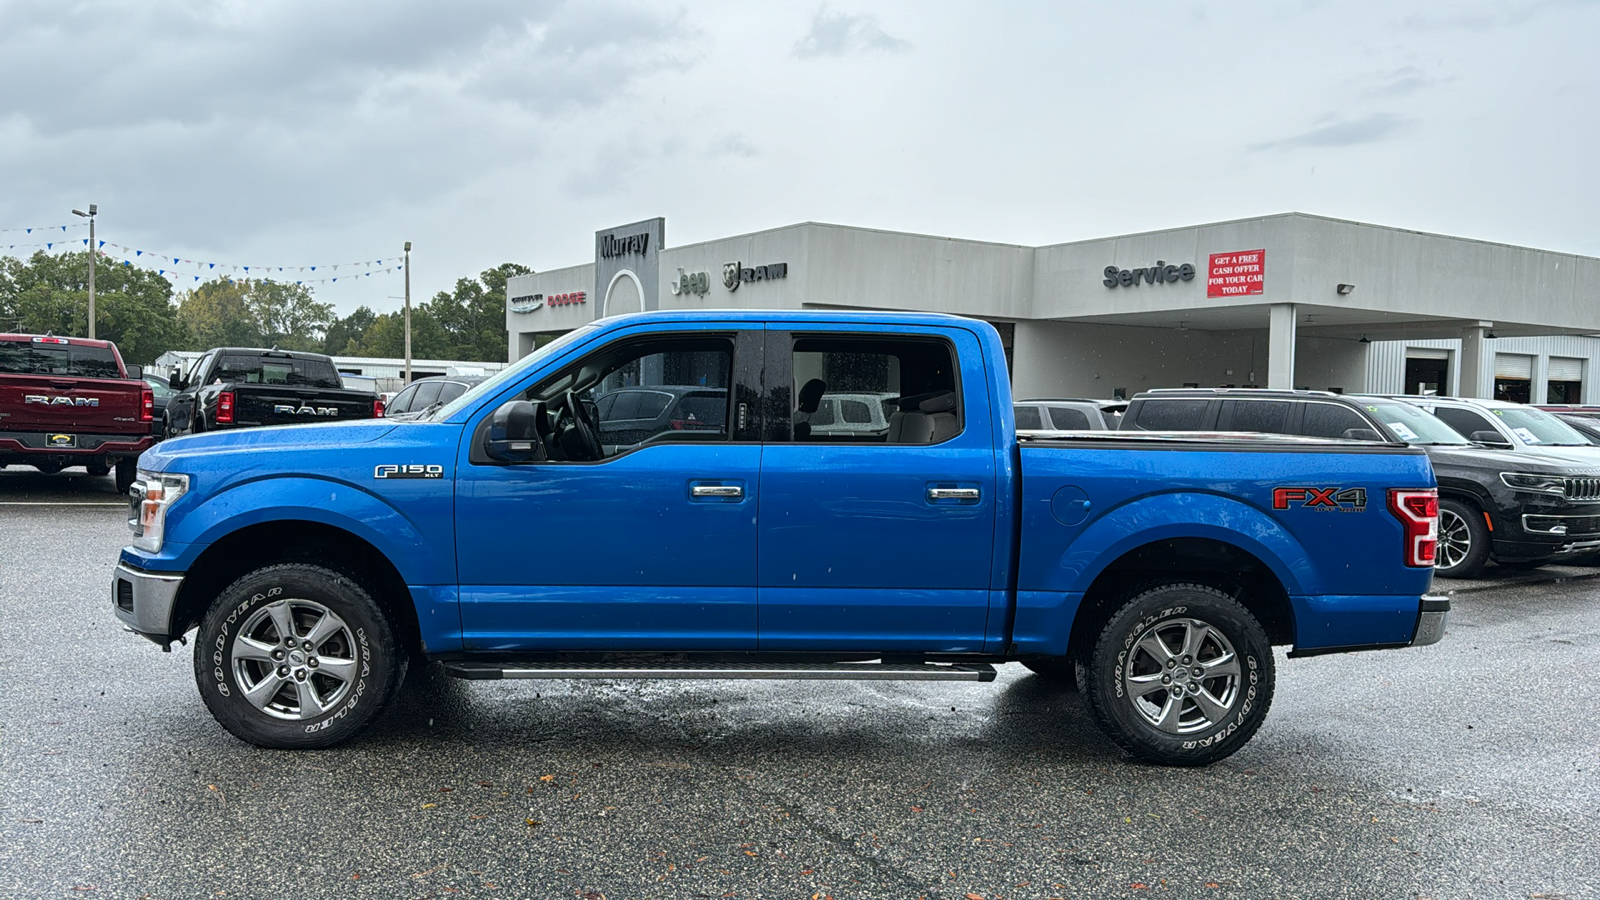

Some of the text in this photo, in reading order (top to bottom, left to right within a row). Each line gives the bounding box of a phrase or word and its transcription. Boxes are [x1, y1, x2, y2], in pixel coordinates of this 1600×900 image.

[601, 233, 649, 258] Murray
[1213, 265, 1260, 275] CASH OFFER
[1214, 254, 1259, 265] GET A FREE
[671, 268, 711, 298] Jeep
[740, 263, 788, 283] RAM
[1103, 260, 1196, 289] Service
[1208, 274, 1264, 286] FOR YOUR CAR
[547, 291, 587, 308] DODGE
[1221, 285, 1248, 294] TODAY
[25, 395, 99, 407] RAM
[274, 405, 339, 416] RAM
[1272, 486, 1368, 510] FX4
[213, 587, 283, 697] GOODYEAR
[1114, 606, 1188, 698] WRANGLER
[305, 628, 370, 733] WRANGLER
[1183, 655, 1258, 749] GOODYEAR
